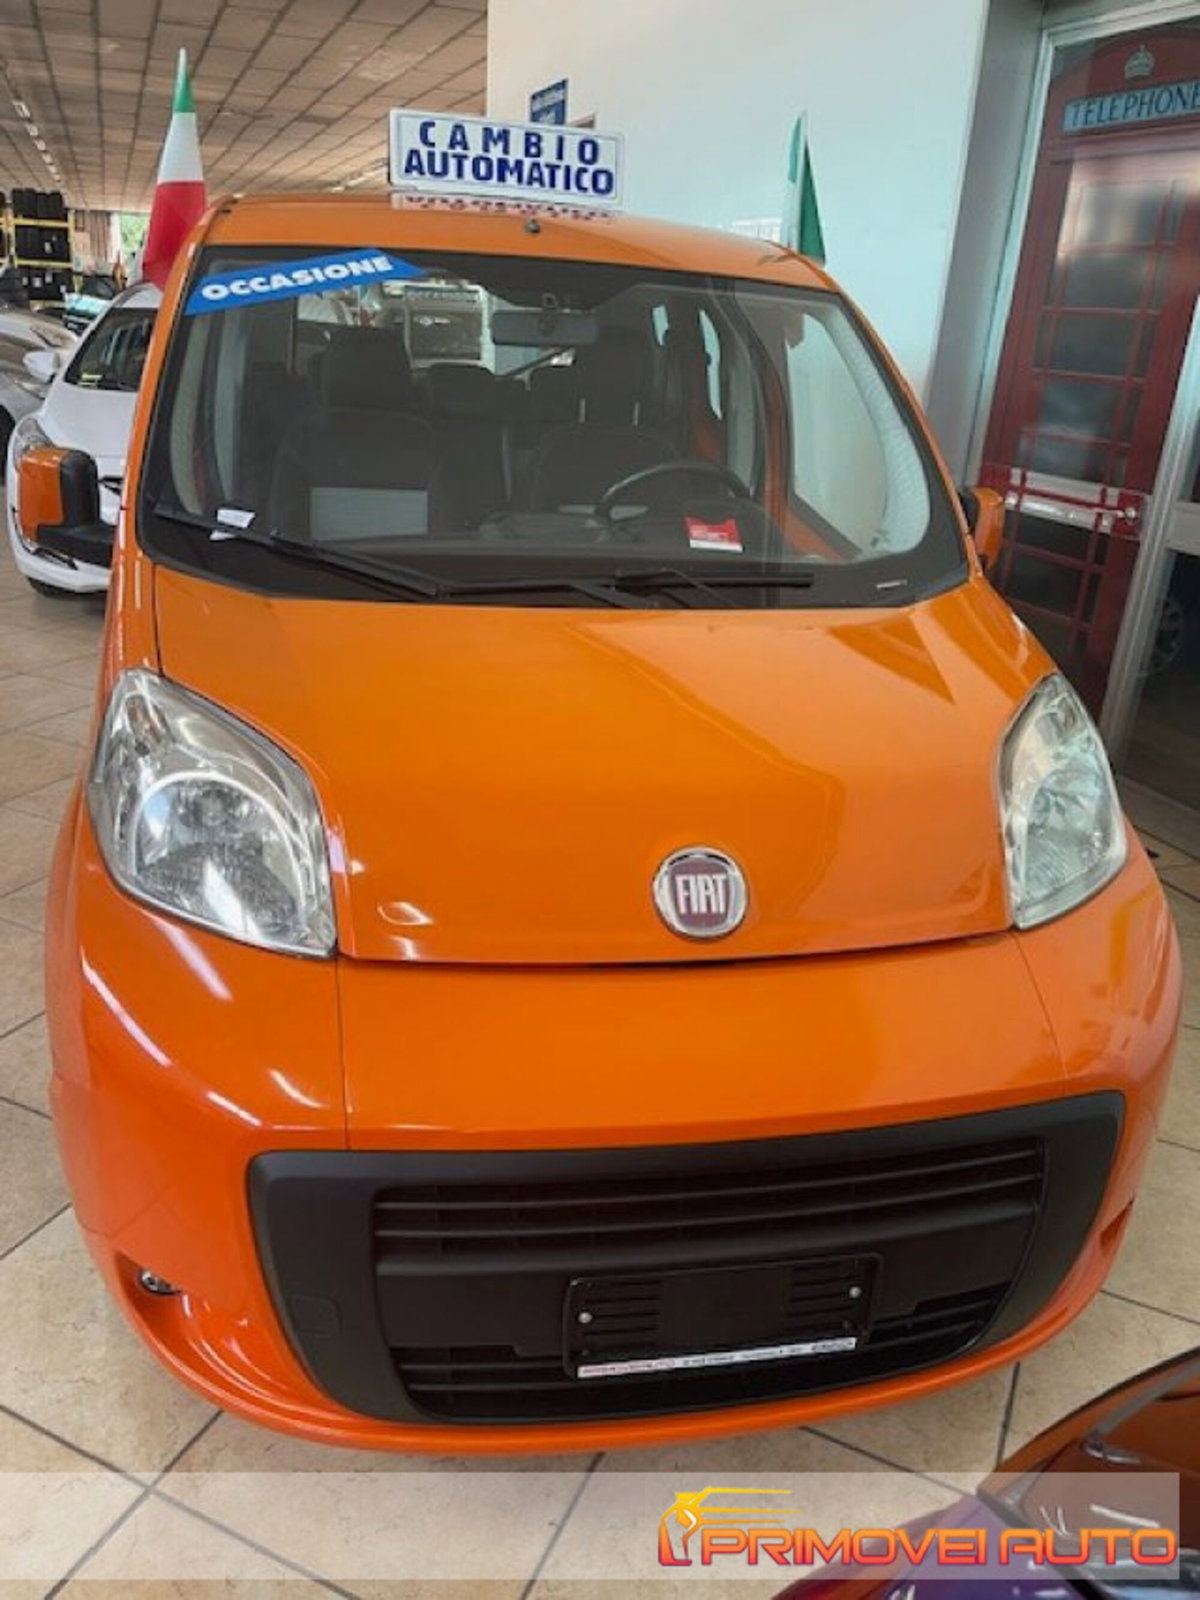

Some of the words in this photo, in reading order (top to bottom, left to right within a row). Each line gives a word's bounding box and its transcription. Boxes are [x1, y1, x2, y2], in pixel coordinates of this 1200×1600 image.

[1069, 83, 1200, 127] TELEPHONE
[419, 120, 600, 166] CAMBIO
[404, 149, 614, 195] AUTOMATICO
[202, 256, 394, 300] OCCASIONE
[675, 873, 727, 915] FIAT
